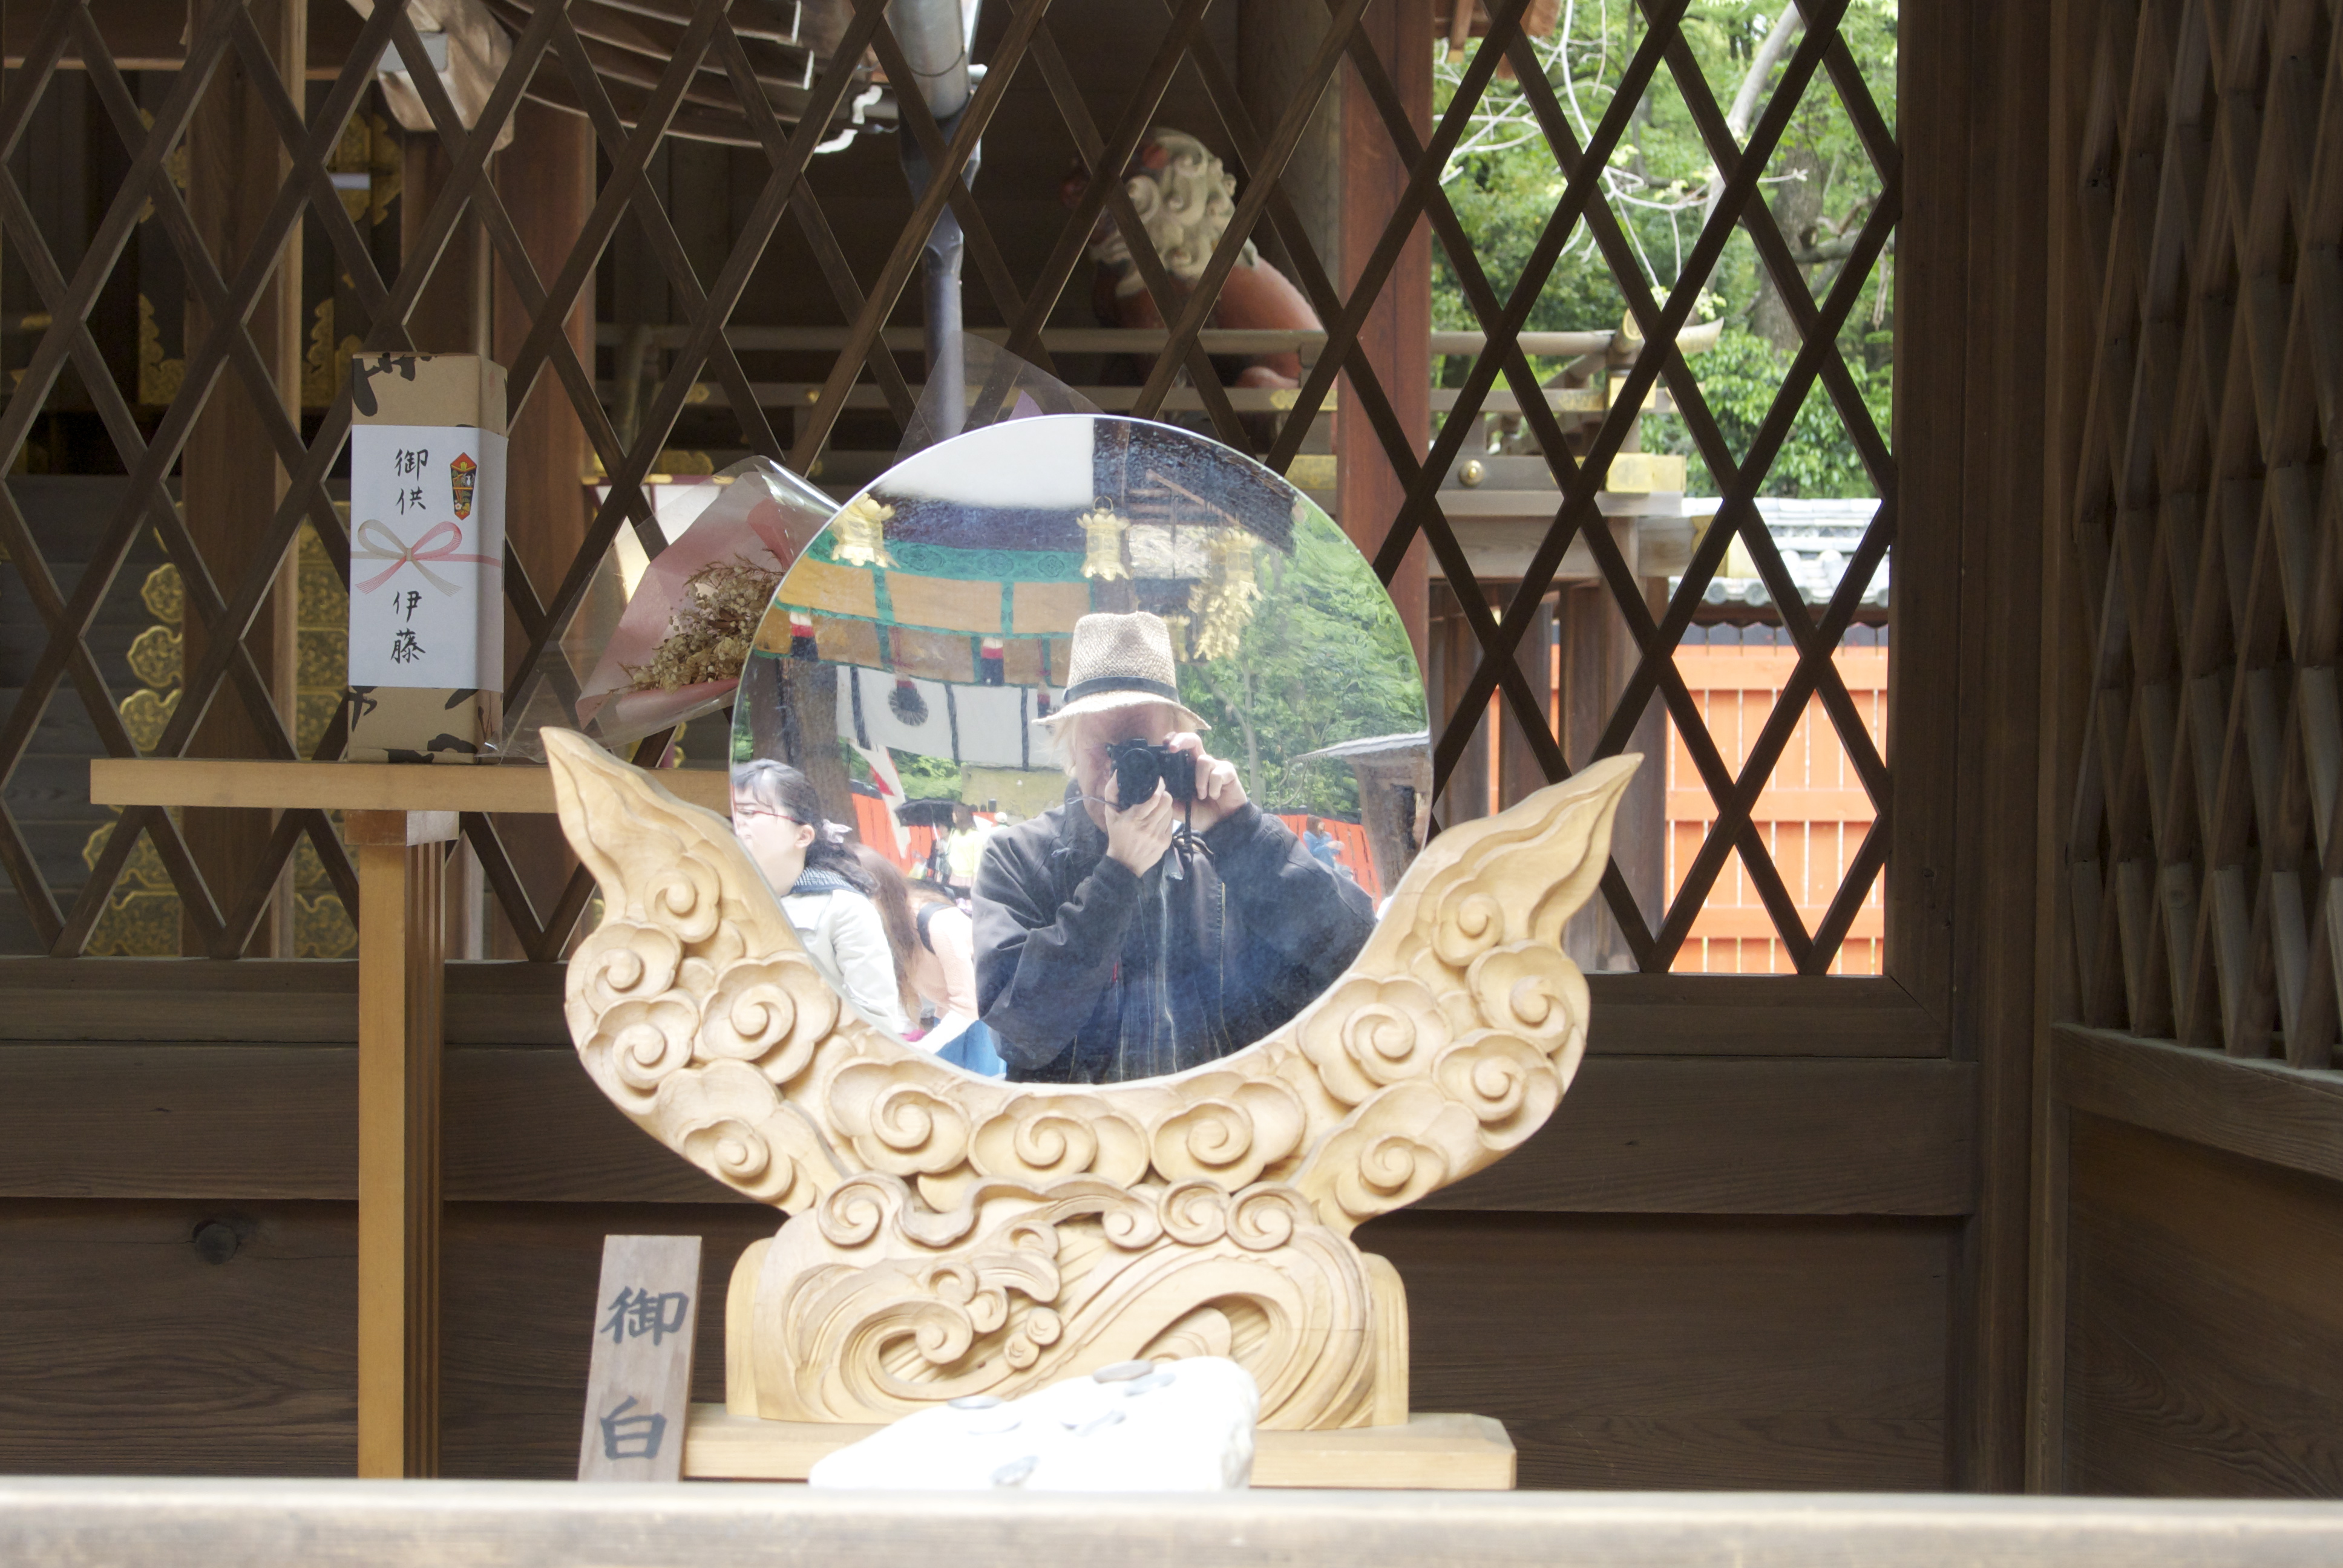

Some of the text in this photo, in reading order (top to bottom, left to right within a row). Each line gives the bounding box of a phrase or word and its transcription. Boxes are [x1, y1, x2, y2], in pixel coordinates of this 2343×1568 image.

[395, 448, 428, 515] 御供
[390, 590, 426, 664] 伊藤
[600, 1286, 690, 1460] 御白
